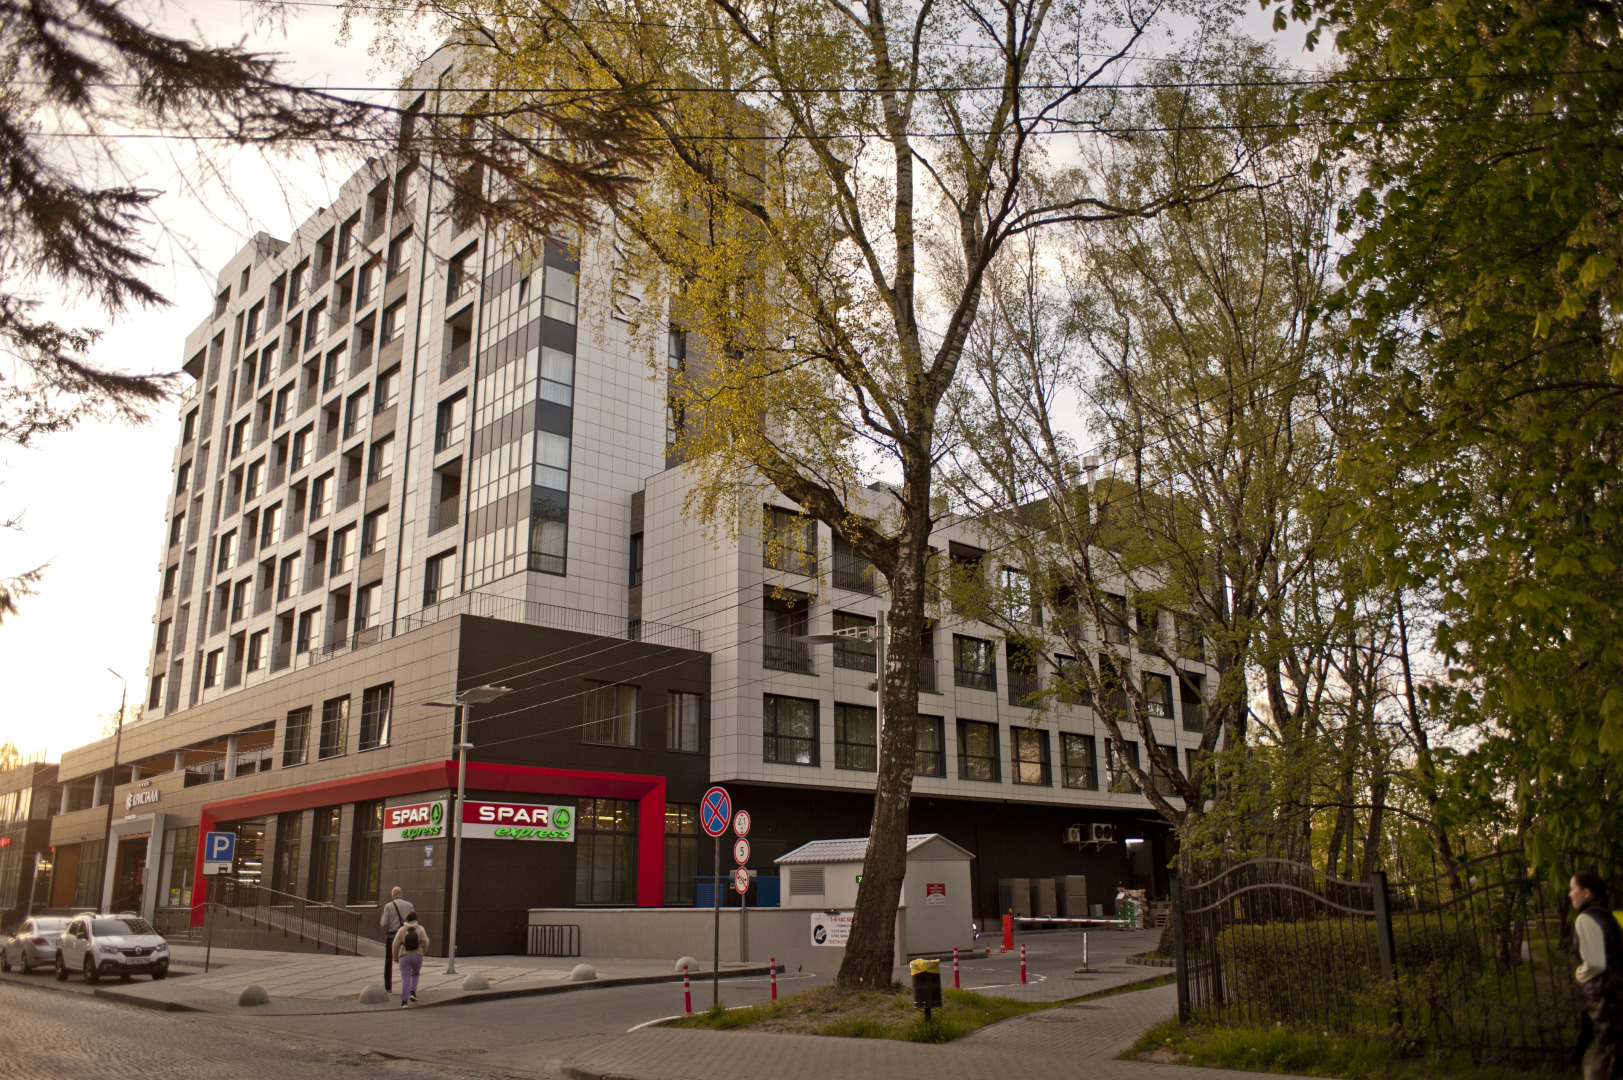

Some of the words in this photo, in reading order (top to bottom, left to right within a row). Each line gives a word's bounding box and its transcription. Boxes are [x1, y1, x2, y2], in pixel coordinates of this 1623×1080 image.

[392, 807, 429, 825] SPAR
[479, 806, 548, 823] SPAR
[400, 826, 440, 839] express
[495, 827, 570, 839] express
[213, 836, 230, 859] P
[740, 847, 745, 857] 5
